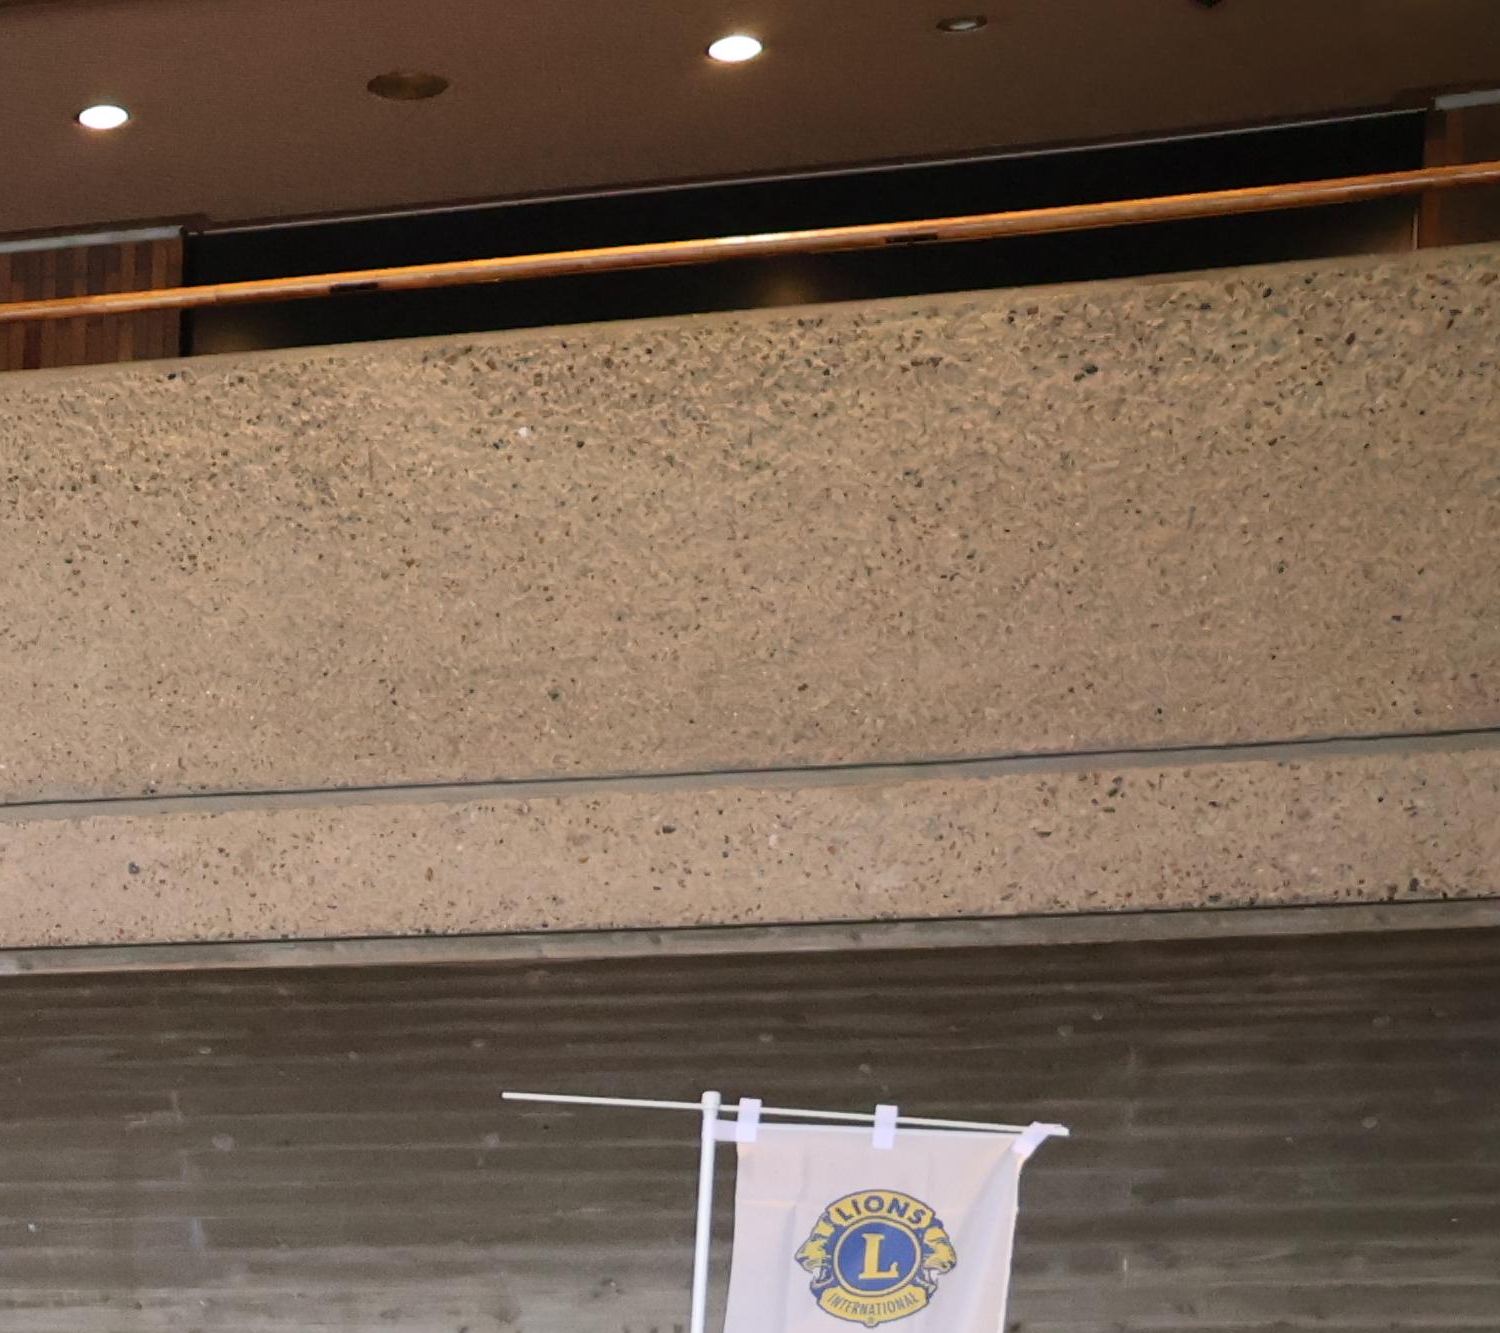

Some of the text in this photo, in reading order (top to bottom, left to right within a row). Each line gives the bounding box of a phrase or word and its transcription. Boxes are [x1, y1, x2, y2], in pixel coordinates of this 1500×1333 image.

[835, 1195, 927, 1225] LIONS
[858, 1232, 900, 1280] L
[827, 1292, 920, 1315] INTERNATIONAL
